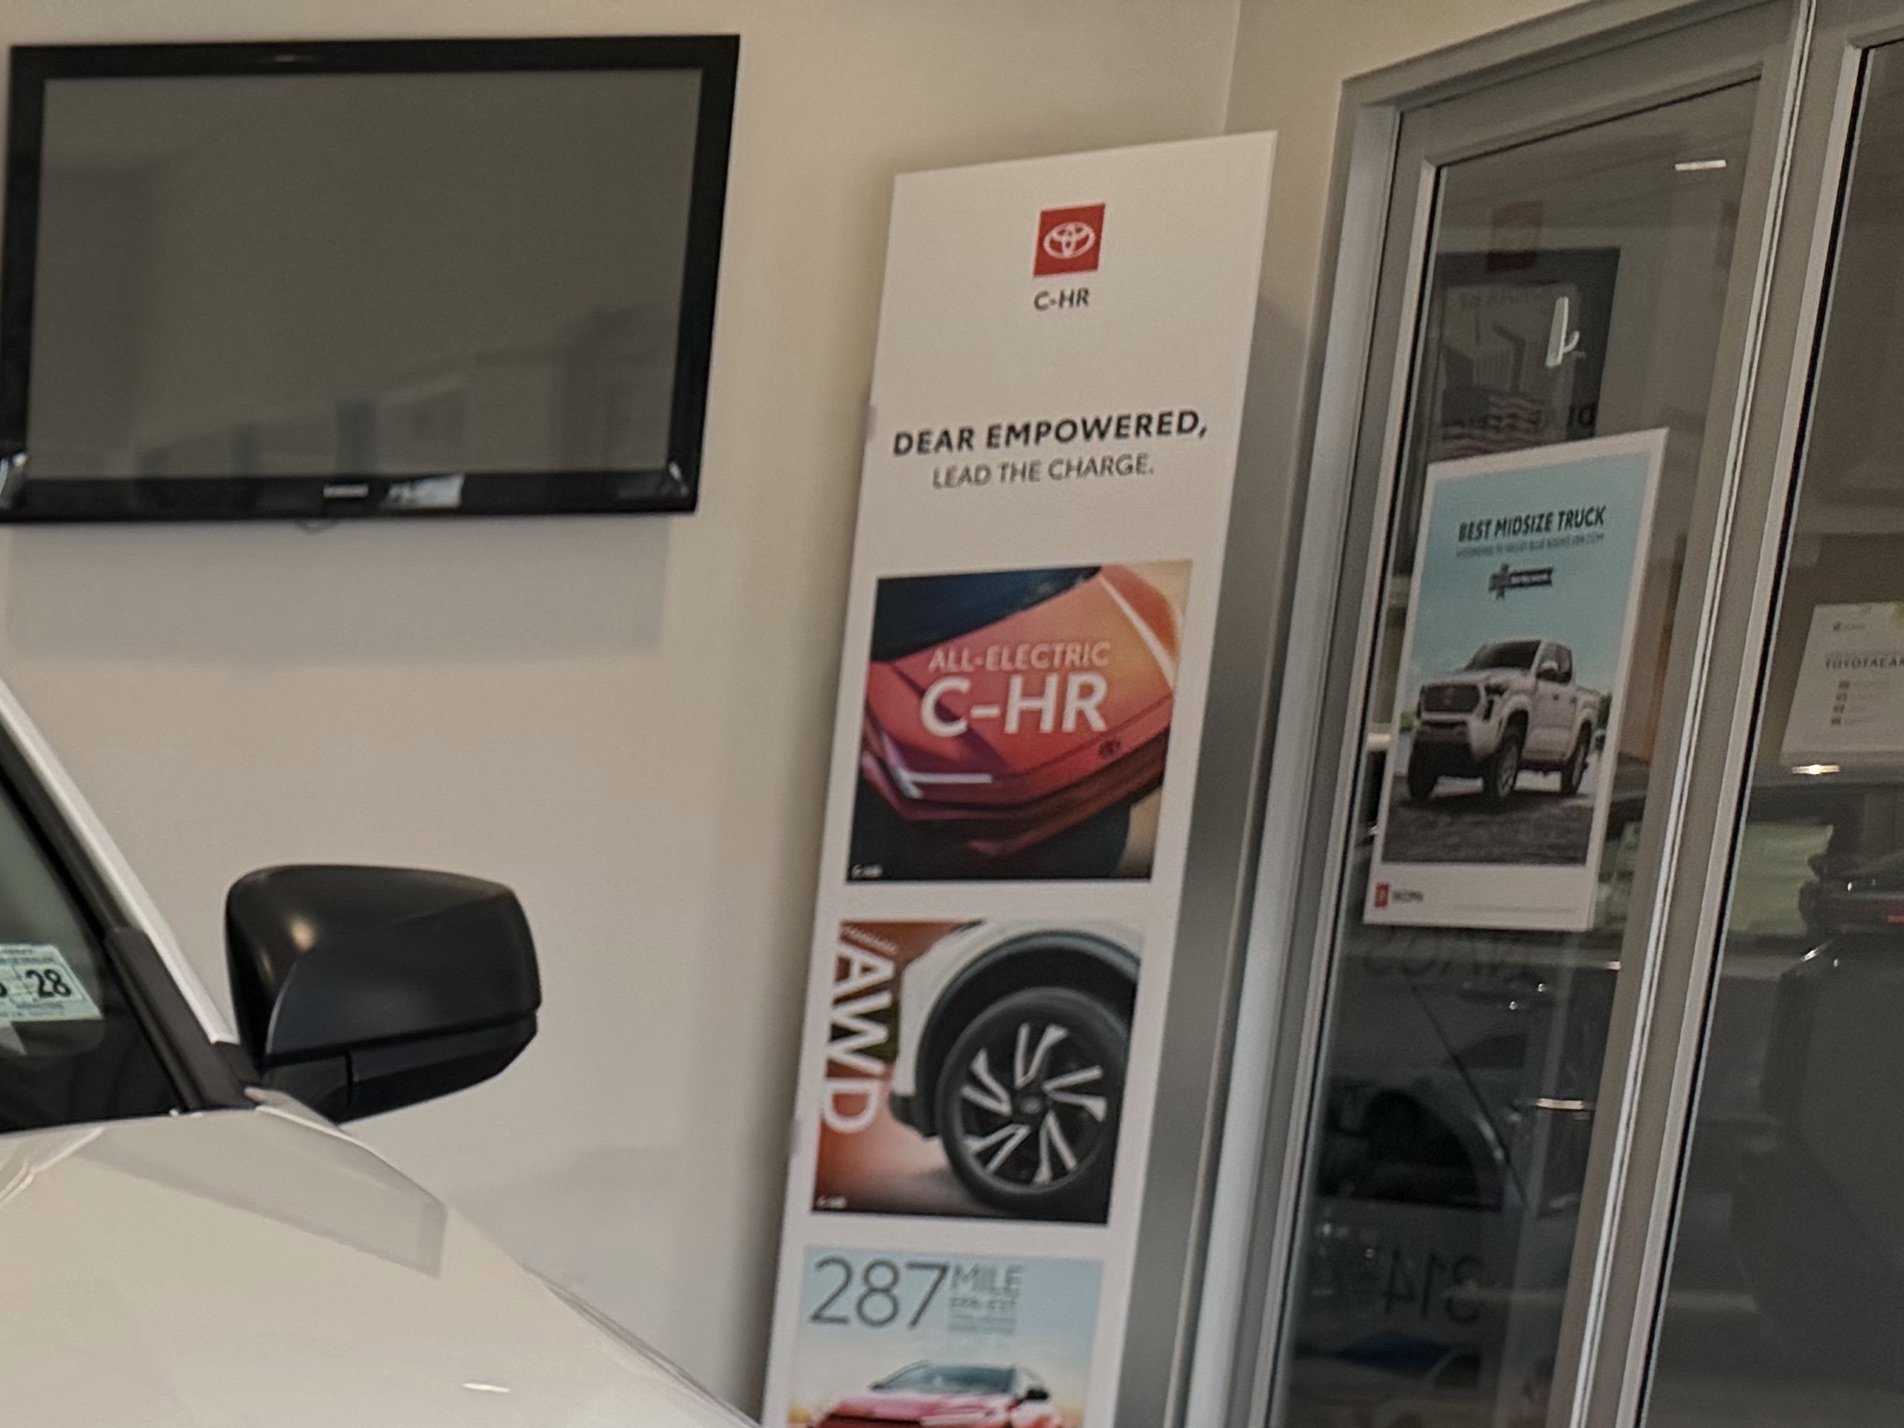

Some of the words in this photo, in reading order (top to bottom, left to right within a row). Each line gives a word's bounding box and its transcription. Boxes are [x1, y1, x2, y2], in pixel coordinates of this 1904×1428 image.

[1033, 287, 1090, 312] C-HR
[893, 425, 975, 456] DEAR
[986, 409, 1207, 450] EMPOWERED,
[932, 464, 991, 490] LEAD
[1000, 459, 1042, 484] THE
[1048, 453, 1155, 482] CHARGE.
[1458, 518, 1493, 542] BEST
[1494, 511, 1554, 539] MIDSIZE
[1557, 505, 1606, 532] TRUCK
[928, 640, 1111, 673] ALL-ELECTRIC
[921, 671, 1108, 738] C-HR
[25, 968, 72, 998] 28
[822, 938, 895, 1133] AWD
[808, 1254, 950, 1330] 287
[950, 1262, 1025, 1297] MILE
